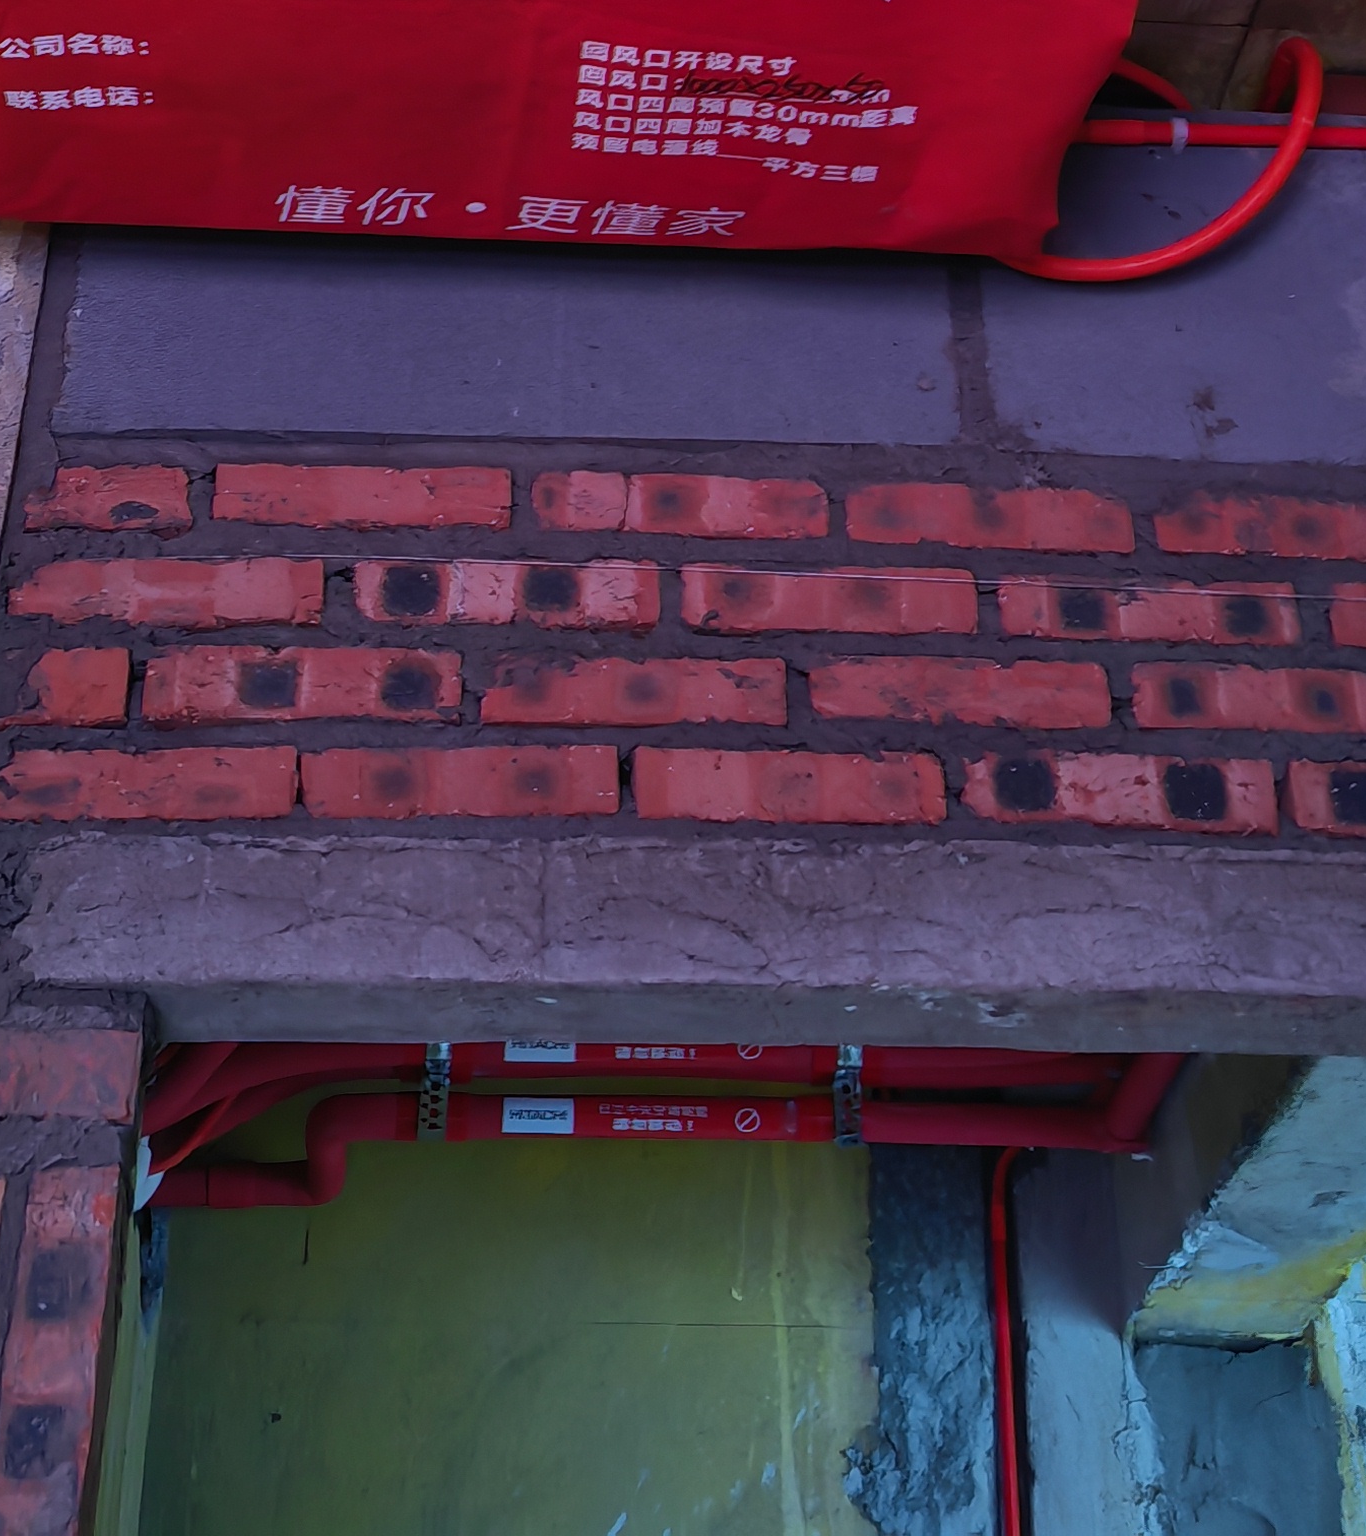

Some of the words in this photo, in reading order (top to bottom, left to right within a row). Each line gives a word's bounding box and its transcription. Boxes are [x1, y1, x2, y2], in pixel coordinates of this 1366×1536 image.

[580, 40, 798, 77] 回风口开设尺寸
[3, 85, 155, 111] 联系电话：
